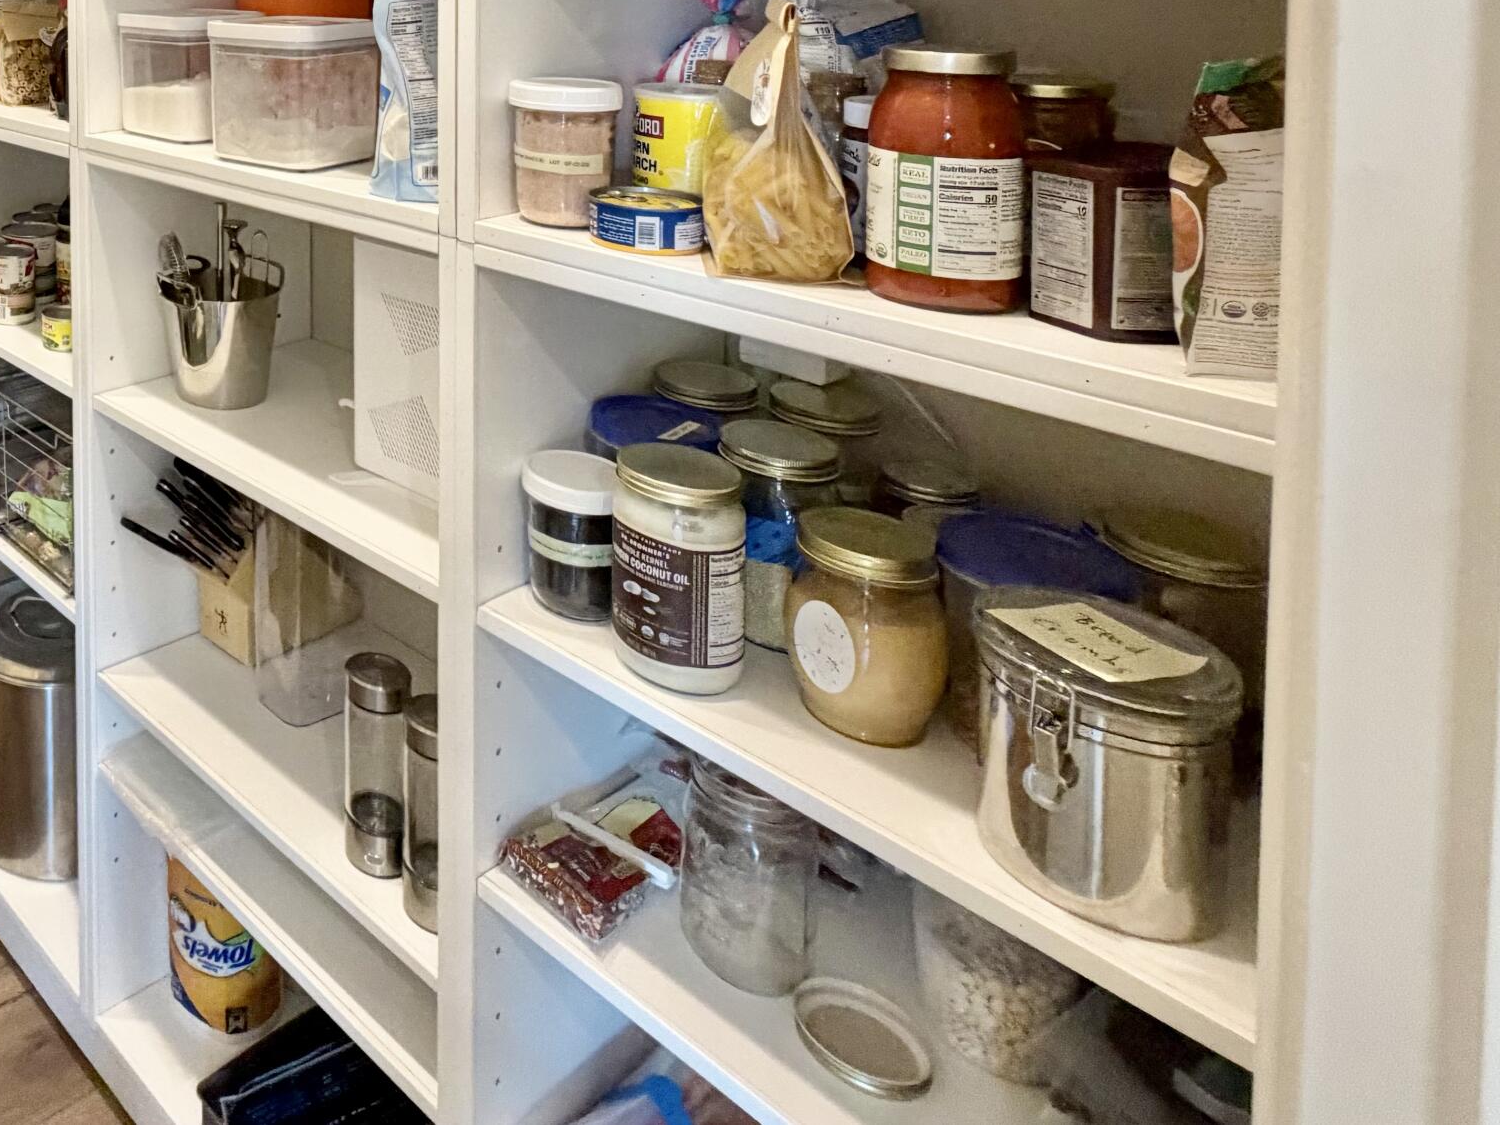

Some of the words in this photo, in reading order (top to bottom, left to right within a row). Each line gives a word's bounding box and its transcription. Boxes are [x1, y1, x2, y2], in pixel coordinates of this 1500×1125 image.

[630, 556, 672, 583] COCONUT
[673, 573, 690, 586] OIL
[182, 935, 256, 969] Towels
